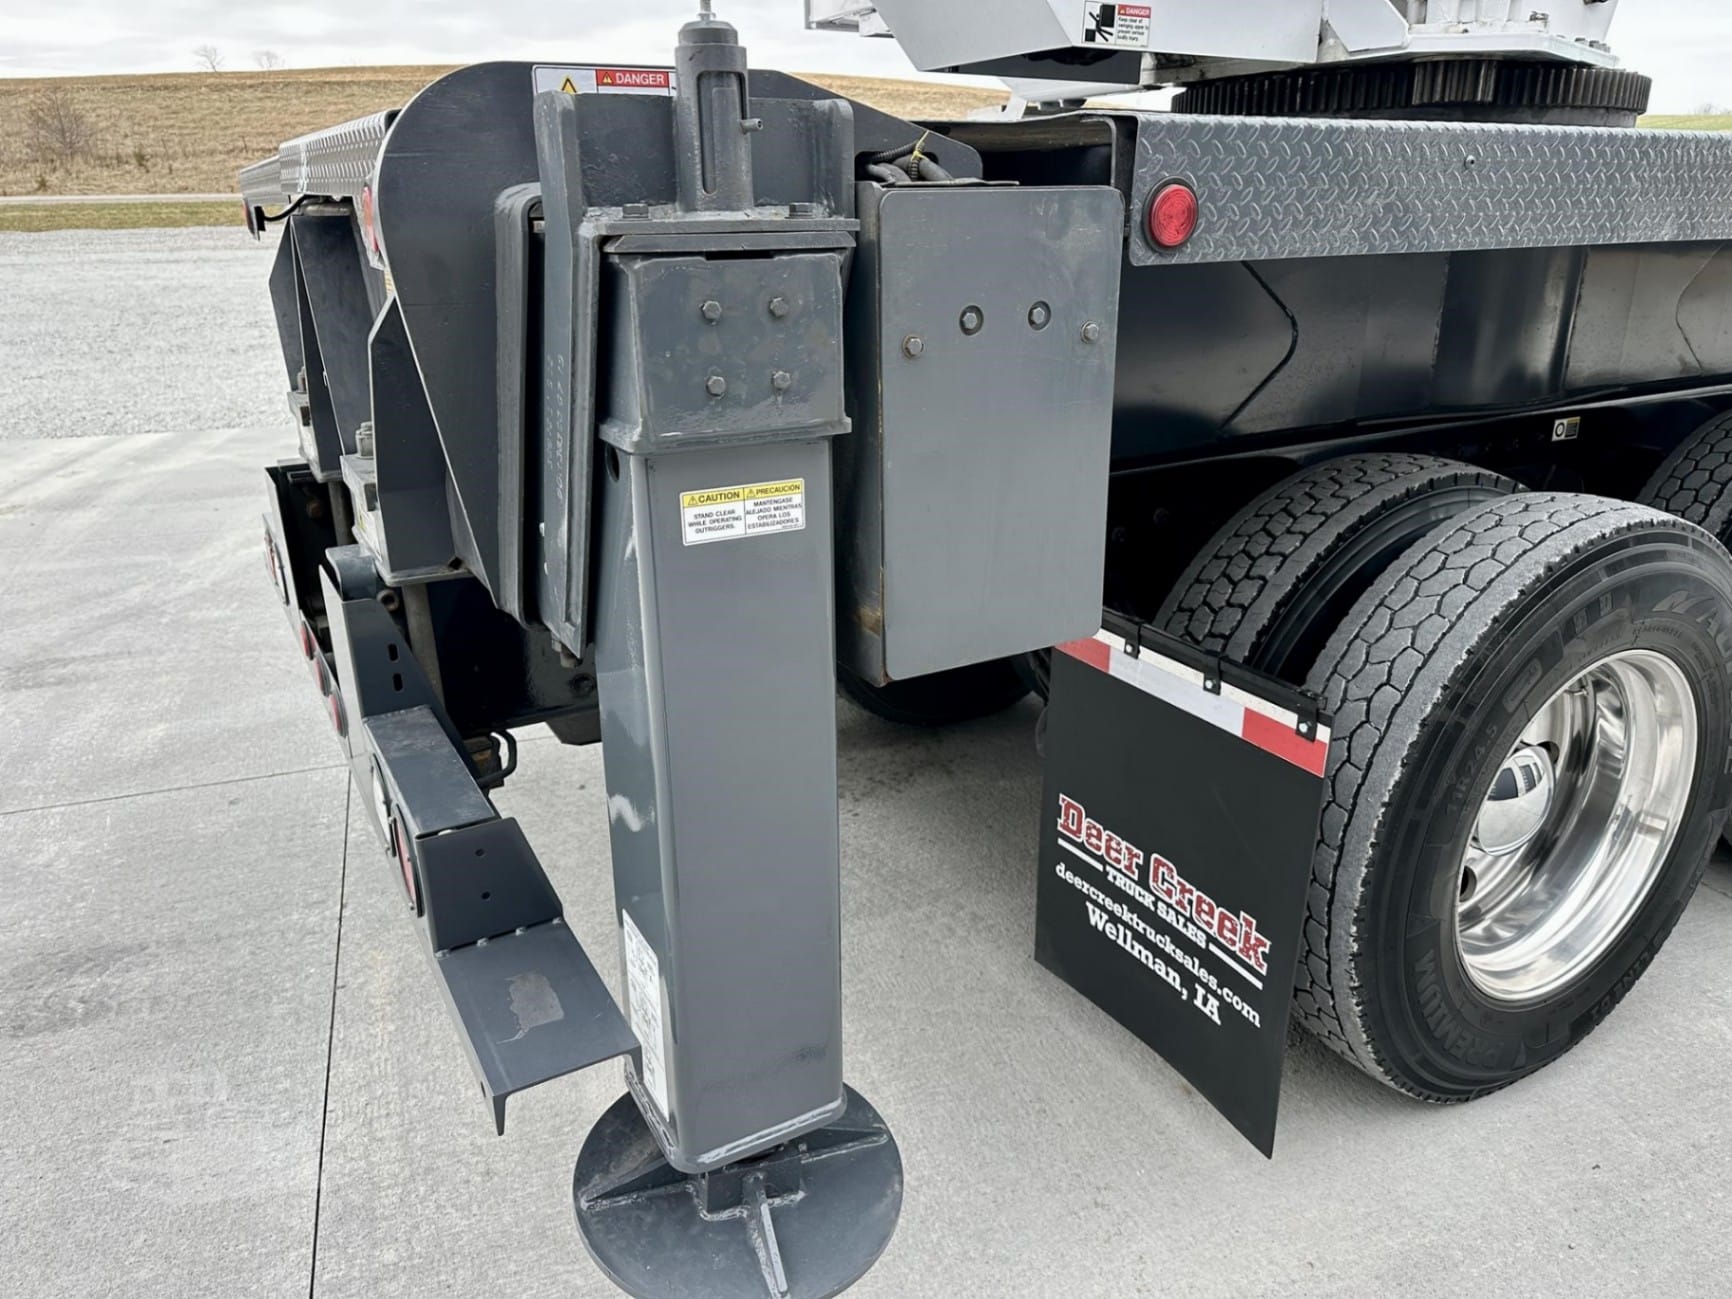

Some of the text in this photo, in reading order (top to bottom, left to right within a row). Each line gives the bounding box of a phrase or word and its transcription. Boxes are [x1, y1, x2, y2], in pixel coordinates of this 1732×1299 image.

[1126, 7, 1150, 16] DANGER
[616, 72, 665, 85] DANGER
[698, 491, 740, 503] CAUTION
[753, 497, 793, 507] MANTENGASE
[693, 509, 736, 520] STAND CLEAR
[746, 503, 802, 515] ALEJADO MIENTRAS
[709, 515, 742, 525] OPERATING
[757, 513, 777, 521] OPERA
[748, 518, 799, 529] ESTABILIZADORES
[1057, 793, 1272, 976] Deer Creek
[1106, 865, 1206, 949] TRUCK SALES
[1055, 862, 1261, 1028] deercreektrucksales.com
[1086, 901, 1222, 1025] Wellman, IA
[1415, 949, 1503, 1069] PREMIUM
